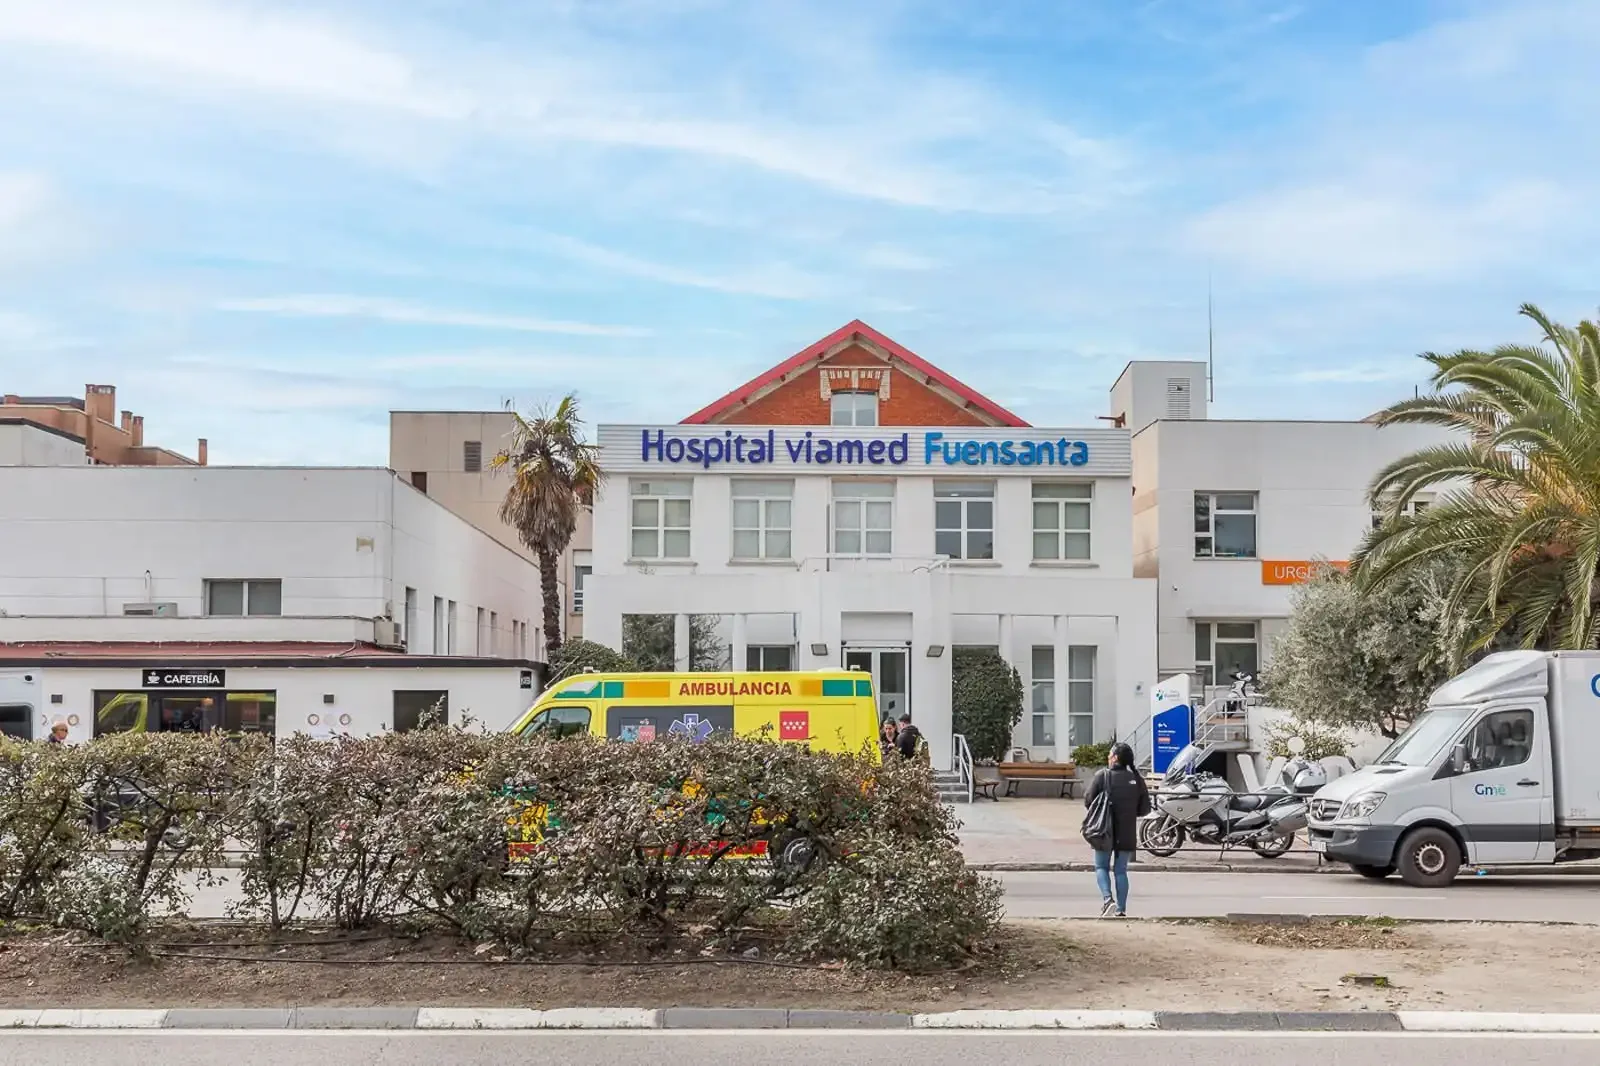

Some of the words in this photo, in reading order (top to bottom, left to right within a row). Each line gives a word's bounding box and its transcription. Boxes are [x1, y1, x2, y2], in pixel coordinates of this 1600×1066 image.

[642, 429, 775, 469] Hospital
[784, 431, 909, 464] viamed
[924, 430, 1090, 466] Fuensanta
[164, 671, 220, 686] CAFETERÍA
[678, 681, 792, 696] AMBULANCIA
